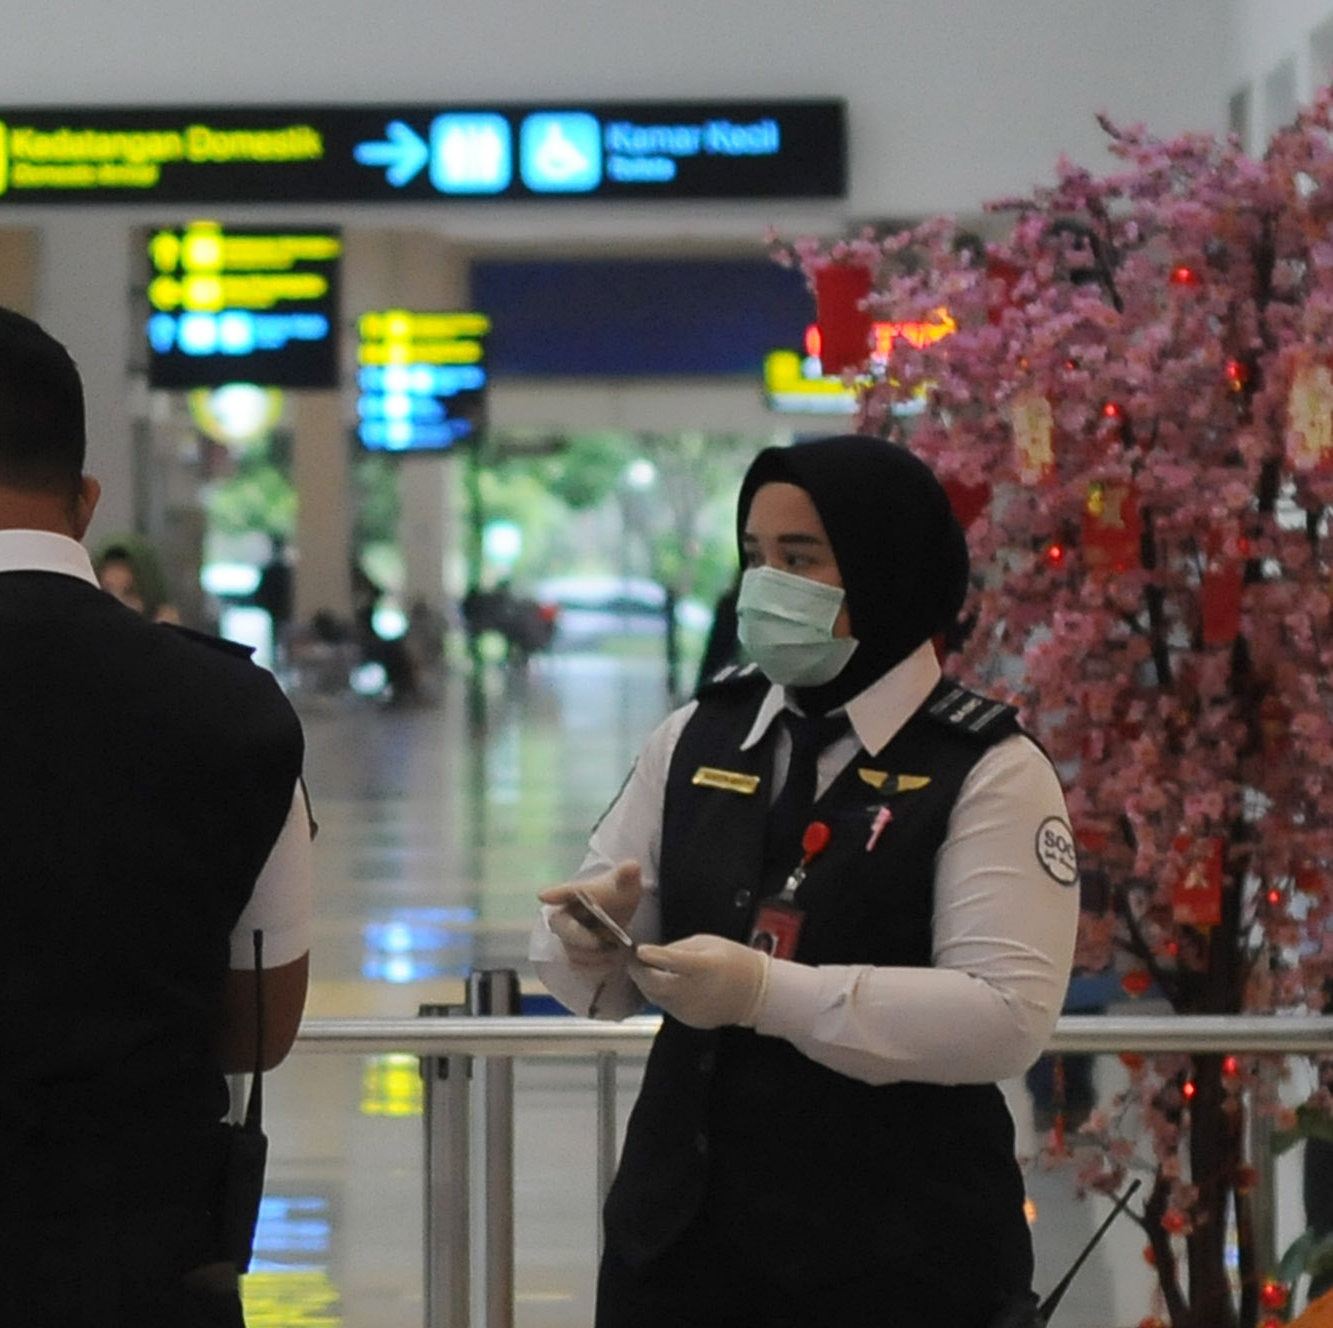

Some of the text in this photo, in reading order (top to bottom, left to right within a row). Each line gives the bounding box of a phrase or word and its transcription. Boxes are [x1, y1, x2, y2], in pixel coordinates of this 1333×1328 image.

[12, 125, 324, 164] Kedatangan Domestik
[606, 117, 780, 156] Kamar Kecil
